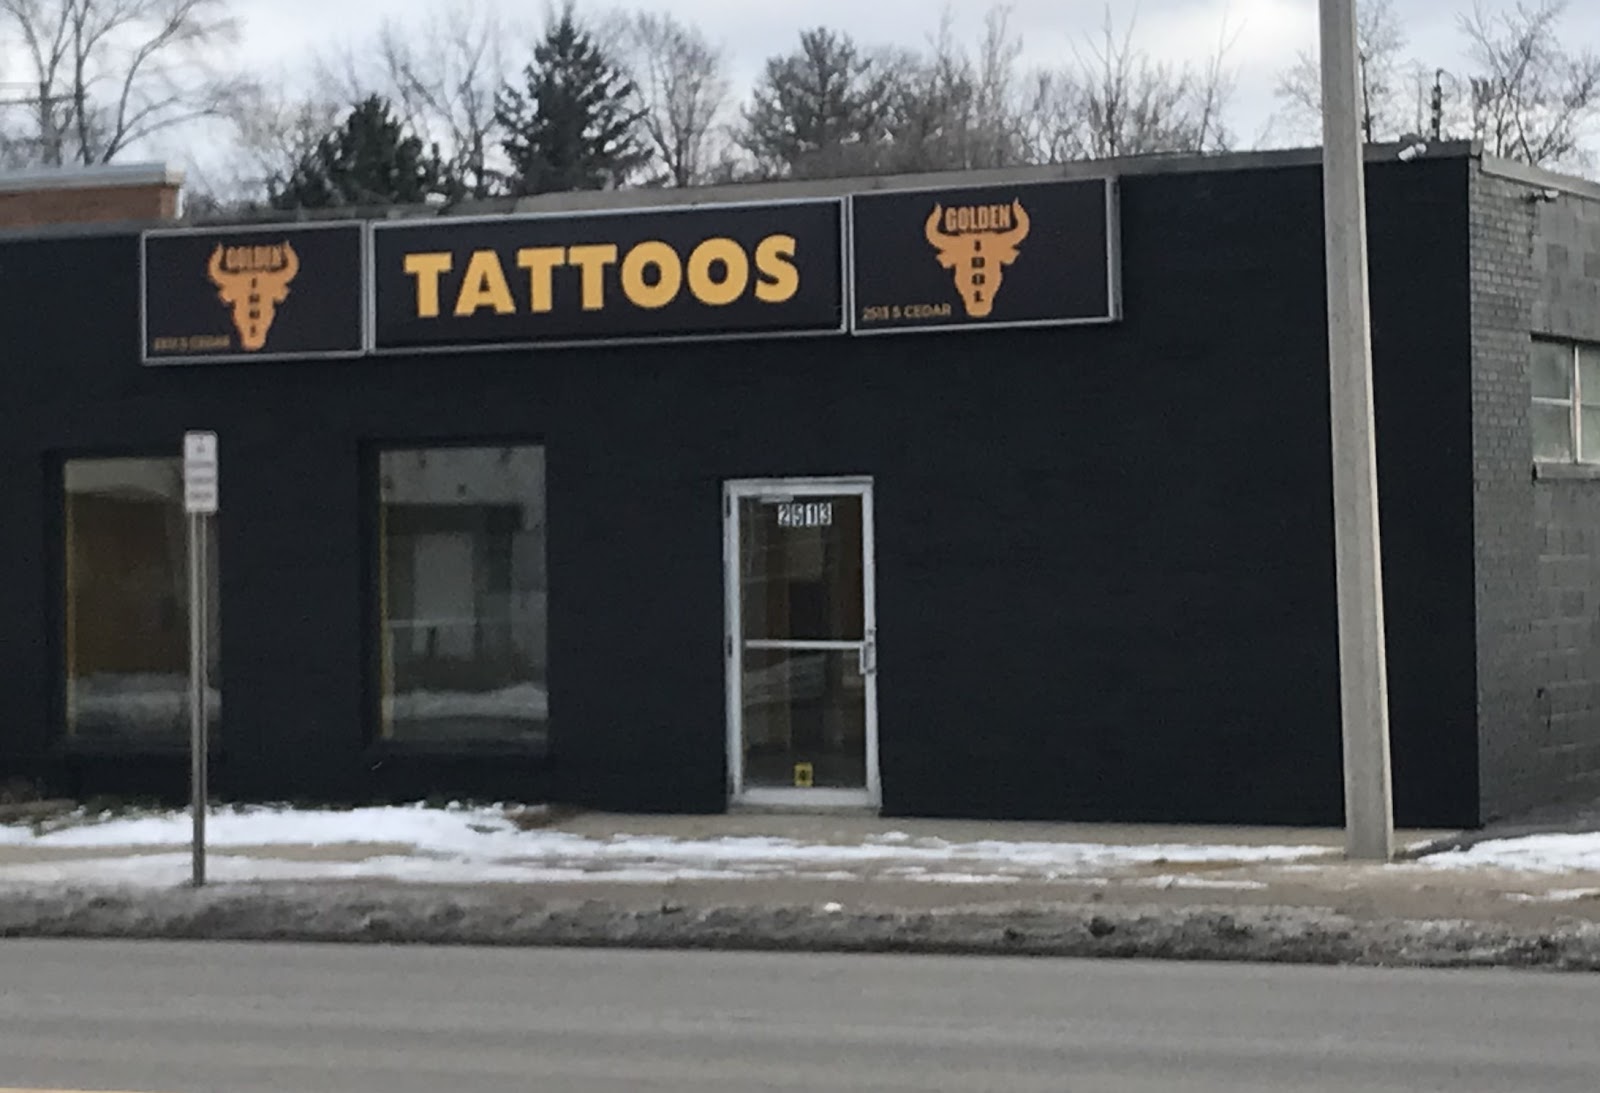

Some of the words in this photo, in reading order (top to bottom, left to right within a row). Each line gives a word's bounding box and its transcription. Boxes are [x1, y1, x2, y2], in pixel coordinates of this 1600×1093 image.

[945, 204, 1012, 230] GOLDEN
[404, 234, 799, 318] TATTOOS
[903, 303, 952, 318] CEDAR
